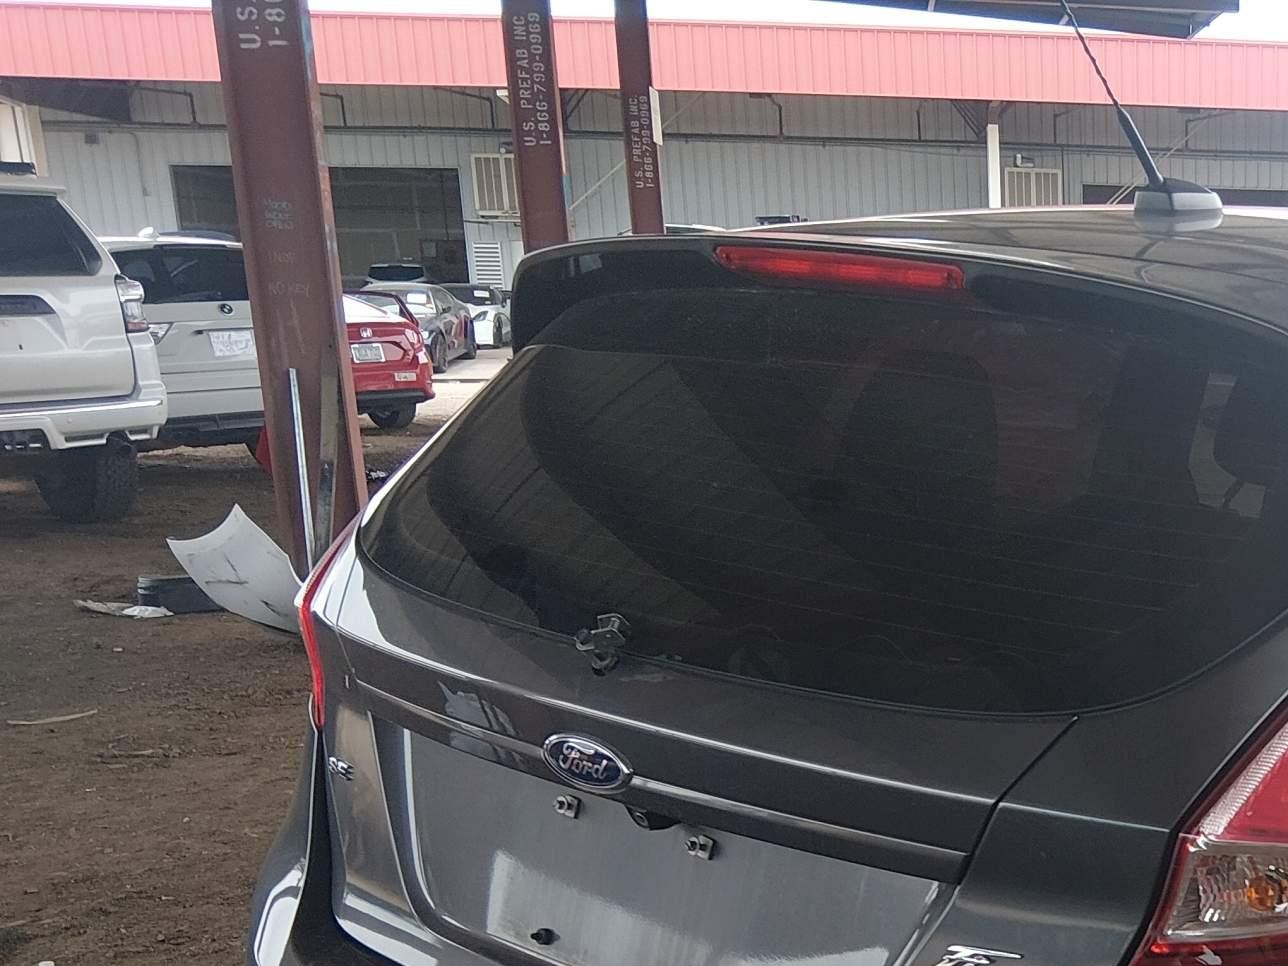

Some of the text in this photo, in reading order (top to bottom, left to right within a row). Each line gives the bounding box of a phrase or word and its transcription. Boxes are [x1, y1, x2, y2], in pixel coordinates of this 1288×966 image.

[512, 15, 537, 146] U.S. PREFAB INC
[527, 12, 552, 144] 1-866-799-0969
[630, 120, 642, 162] PREFAB
[635, 167, 644, 188] U.S.
[328, 756, 353, 780] SE
[559, 742, 608, 779] Ford
